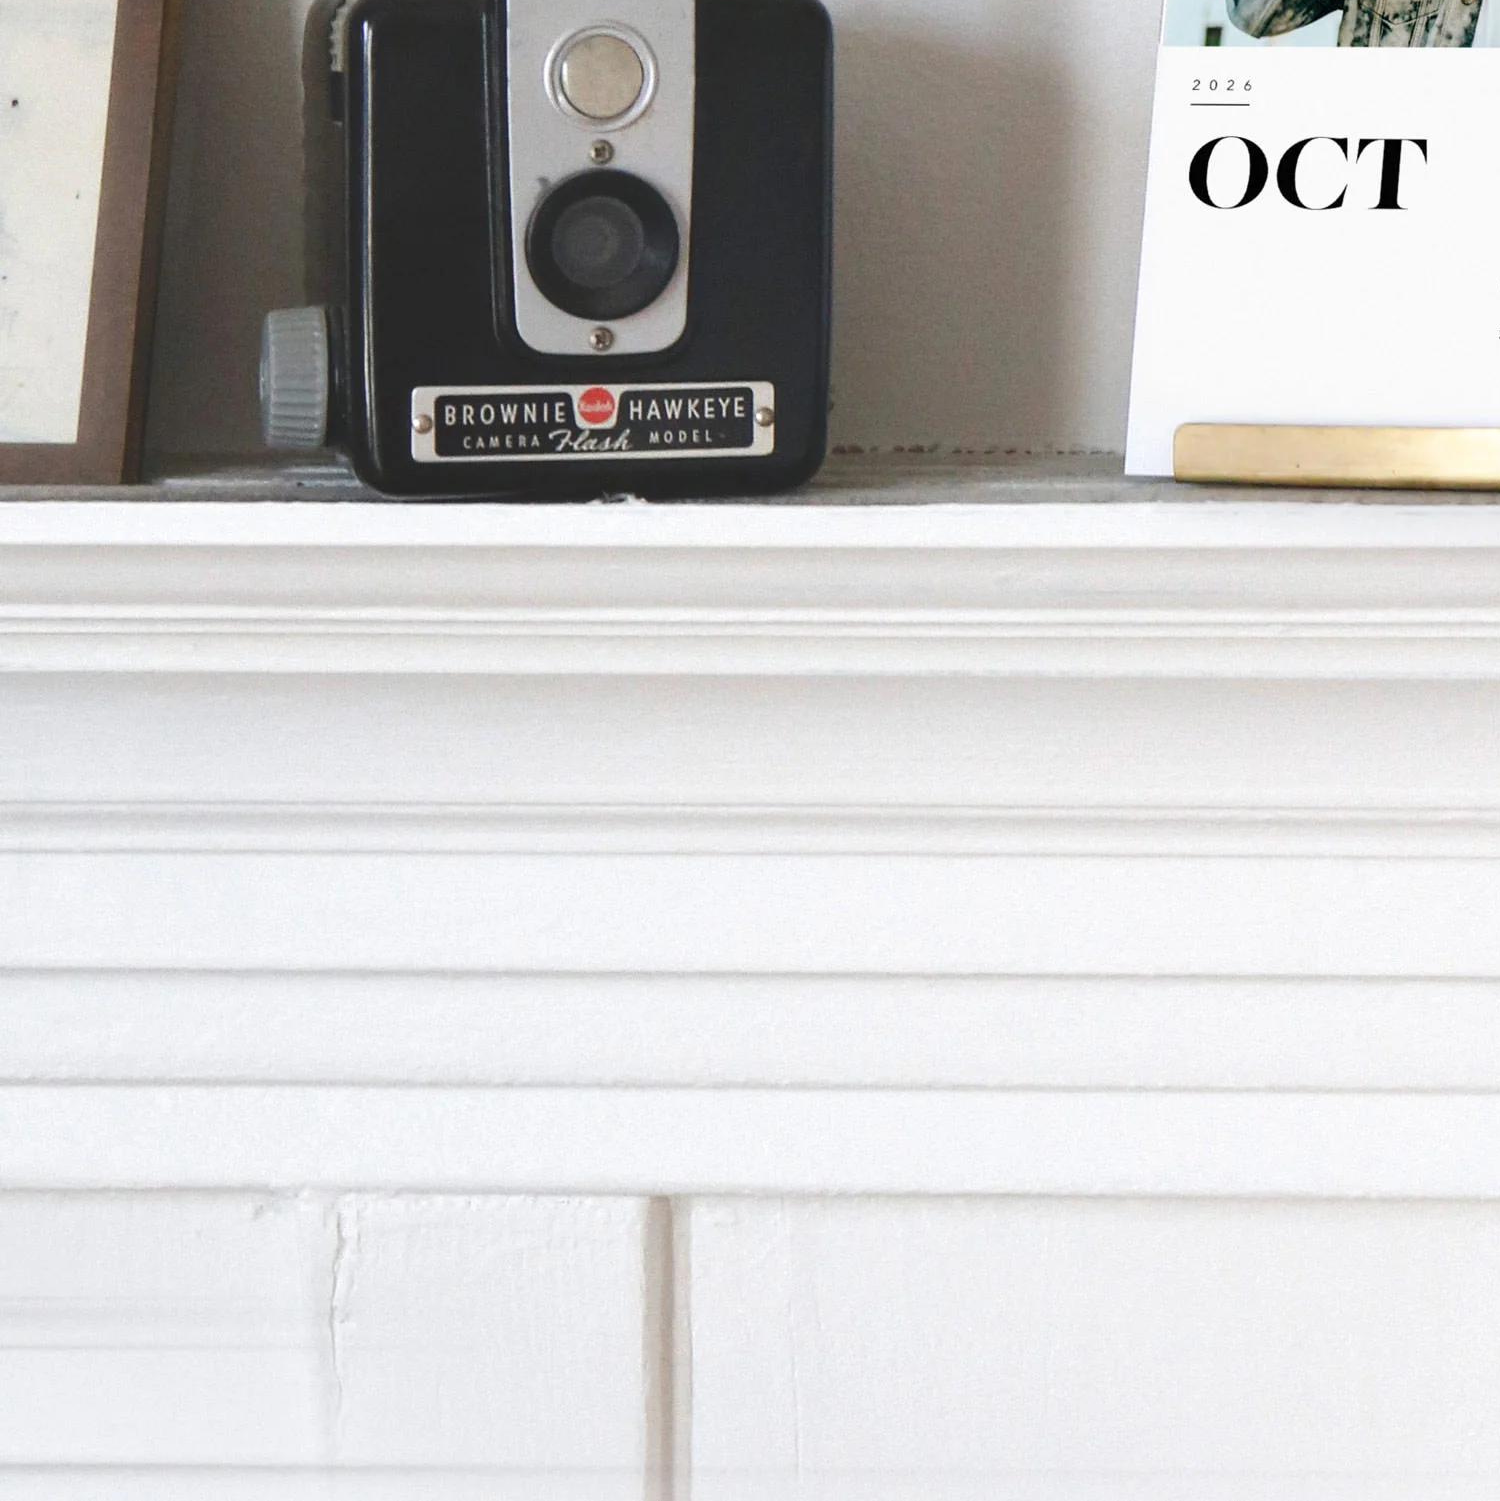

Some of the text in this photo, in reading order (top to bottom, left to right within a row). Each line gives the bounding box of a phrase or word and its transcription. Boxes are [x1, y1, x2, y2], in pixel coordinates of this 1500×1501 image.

[1192, 79, 1252, 91] 2026
[1189, 136, 1428, 210] OCT
[444, 397, 746, 426] BROWNIE HAWKEYE
[463, 428, 713, 452] CAMERA Flash MODEL
